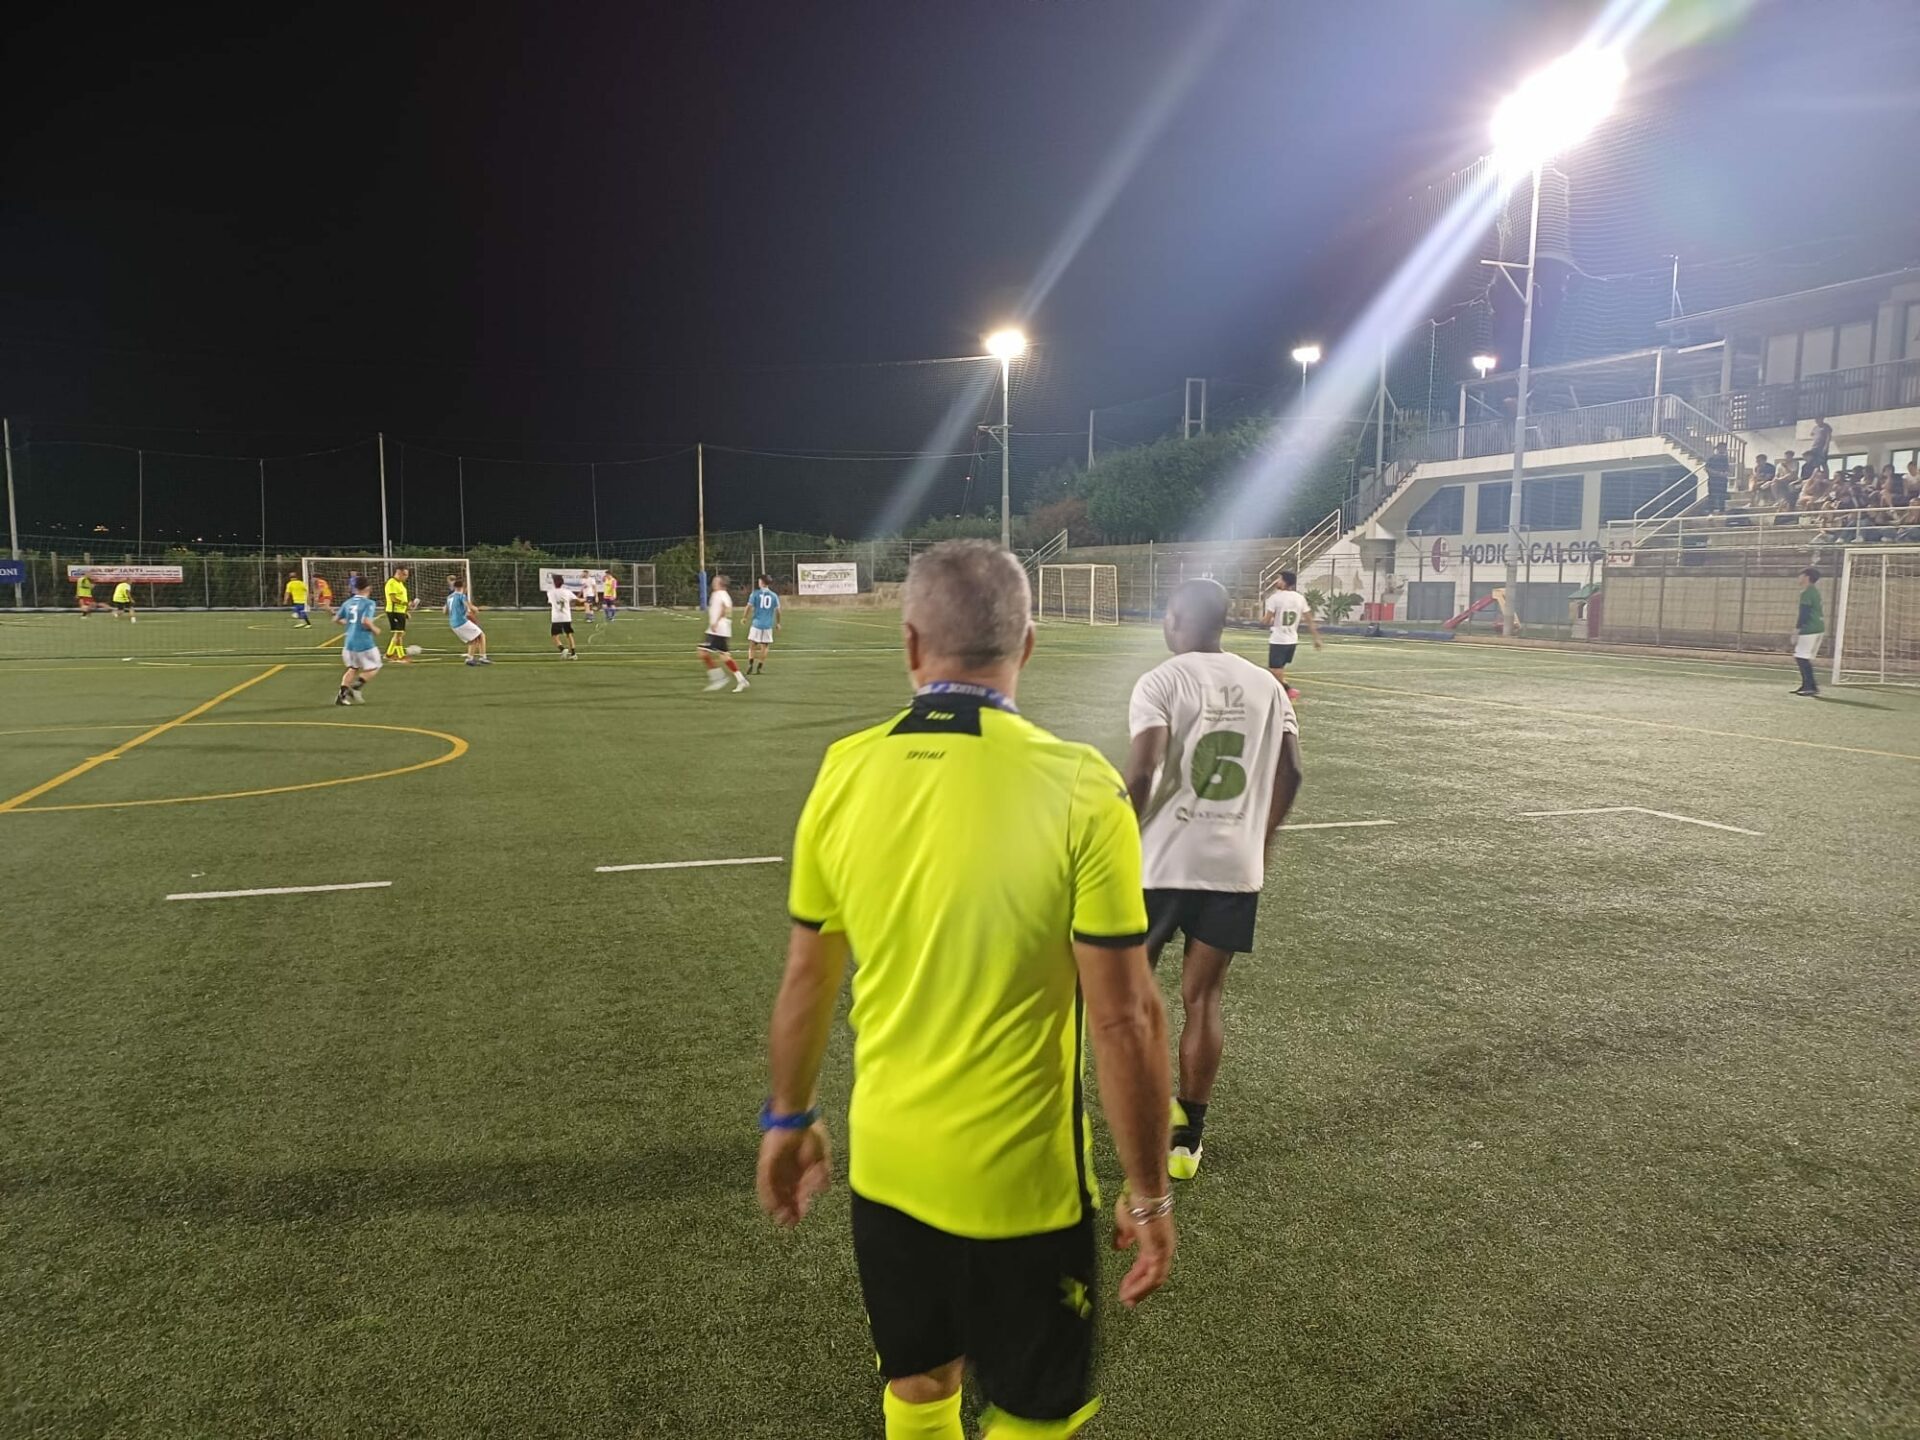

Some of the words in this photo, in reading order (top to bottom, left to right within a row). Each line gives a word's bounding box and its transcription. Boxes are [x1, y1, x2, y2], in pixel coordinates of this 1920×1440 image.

[1530, 541, 1601, 564] CALCIO
[758, 593, 772, 609] 10
[348, 604, 359, 624] 3
[1282, 610, 1298, 627] 19
[1219, 683, 1245, 708] 12
[1190, 730, 1247, 802] 6
